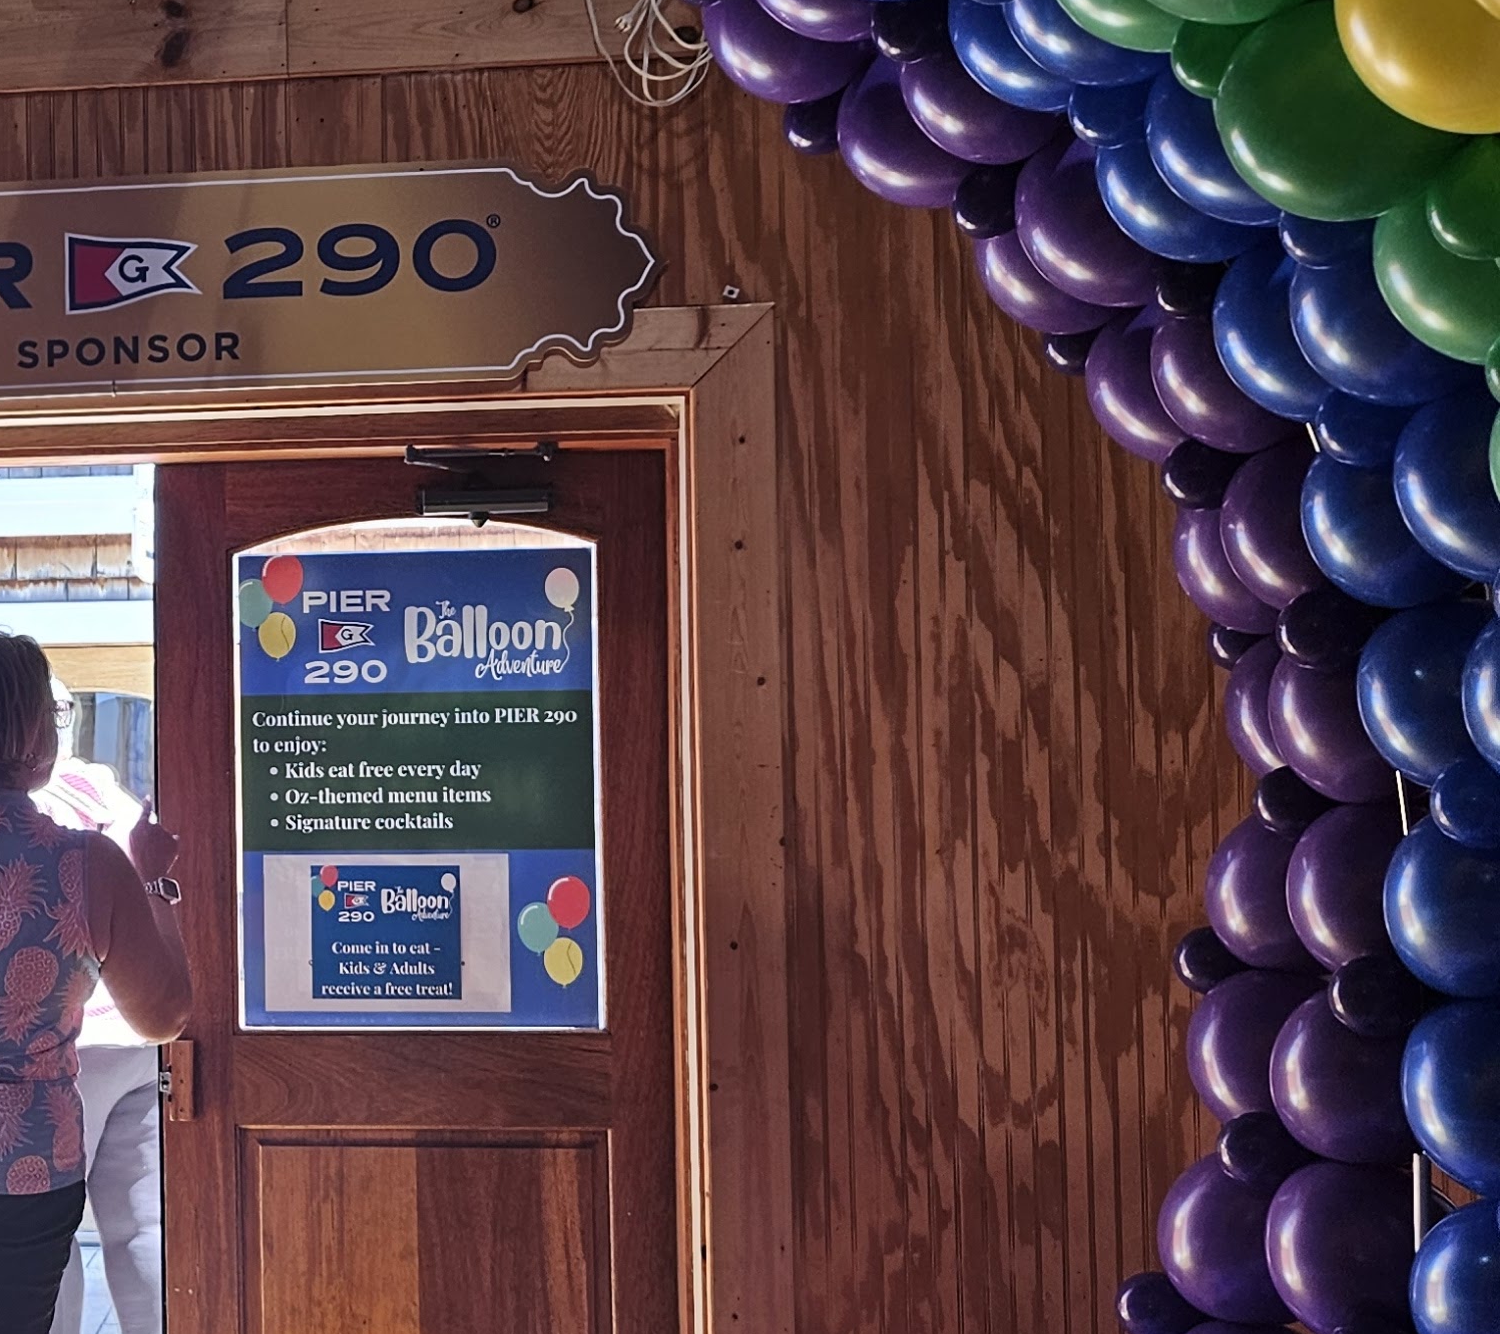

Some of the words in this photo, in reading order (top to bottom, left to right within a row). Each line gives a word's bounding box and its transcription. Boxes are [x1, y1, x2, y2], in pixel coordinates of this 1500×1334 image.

[118, 254, 151, 284] G
[16, 331, 241, 369] SPONSOR
[303, 589, 391, 614] PIER
[435, 600, 457, 620] The
[404, 604, 562, 664] Balloon
[304, 659, 388, 684] 290
[474, 648, 563, 681] Adventure
[252, 710, 333, 727] Continue
[336, 713, 378, 729] your
[381, 709, 450, 728] journey
[454, 708, 490, 724] into
[494, 707, 540, 723] PIER
[543, 709, 578, 725] 290
[252, 738, 270, 753] to
[274, 735, 327, 755] enjoy:
[285, 761, 325, 779] Kids
[328, 763, 355, 778] eat
[358, 761, 394, 778] free
[397, 764, 446, 780] every
[449, 760, 482, 780] day
[285, 787, 384, 805] Oz-themed
[387, 791, 438, 804] menu
[442, 786, 492, 804] items
[285, 814, 371, 834] Signature
[374, 812, 454, 830] cocktails
[337, 880, 376, 892] PIER
[380, 888, 449, 915] Balloon
[338, 911, 375, 922] 290
[331, 941, 373, 955] Come
[375, 940, 389, 954] in
[392, 942, 406, 955] to
[409, 942, 430, 955] eat
[339, 961, 370, 975] Kids
[373, 962, 387, 975] &
[389, 961, 435, 975] Adults
[321, 982, 371, 995] receive
[373, 985, 382, 995] a
[385, 981, 413, 995] free
[416, 982, 453, 996] treat!
